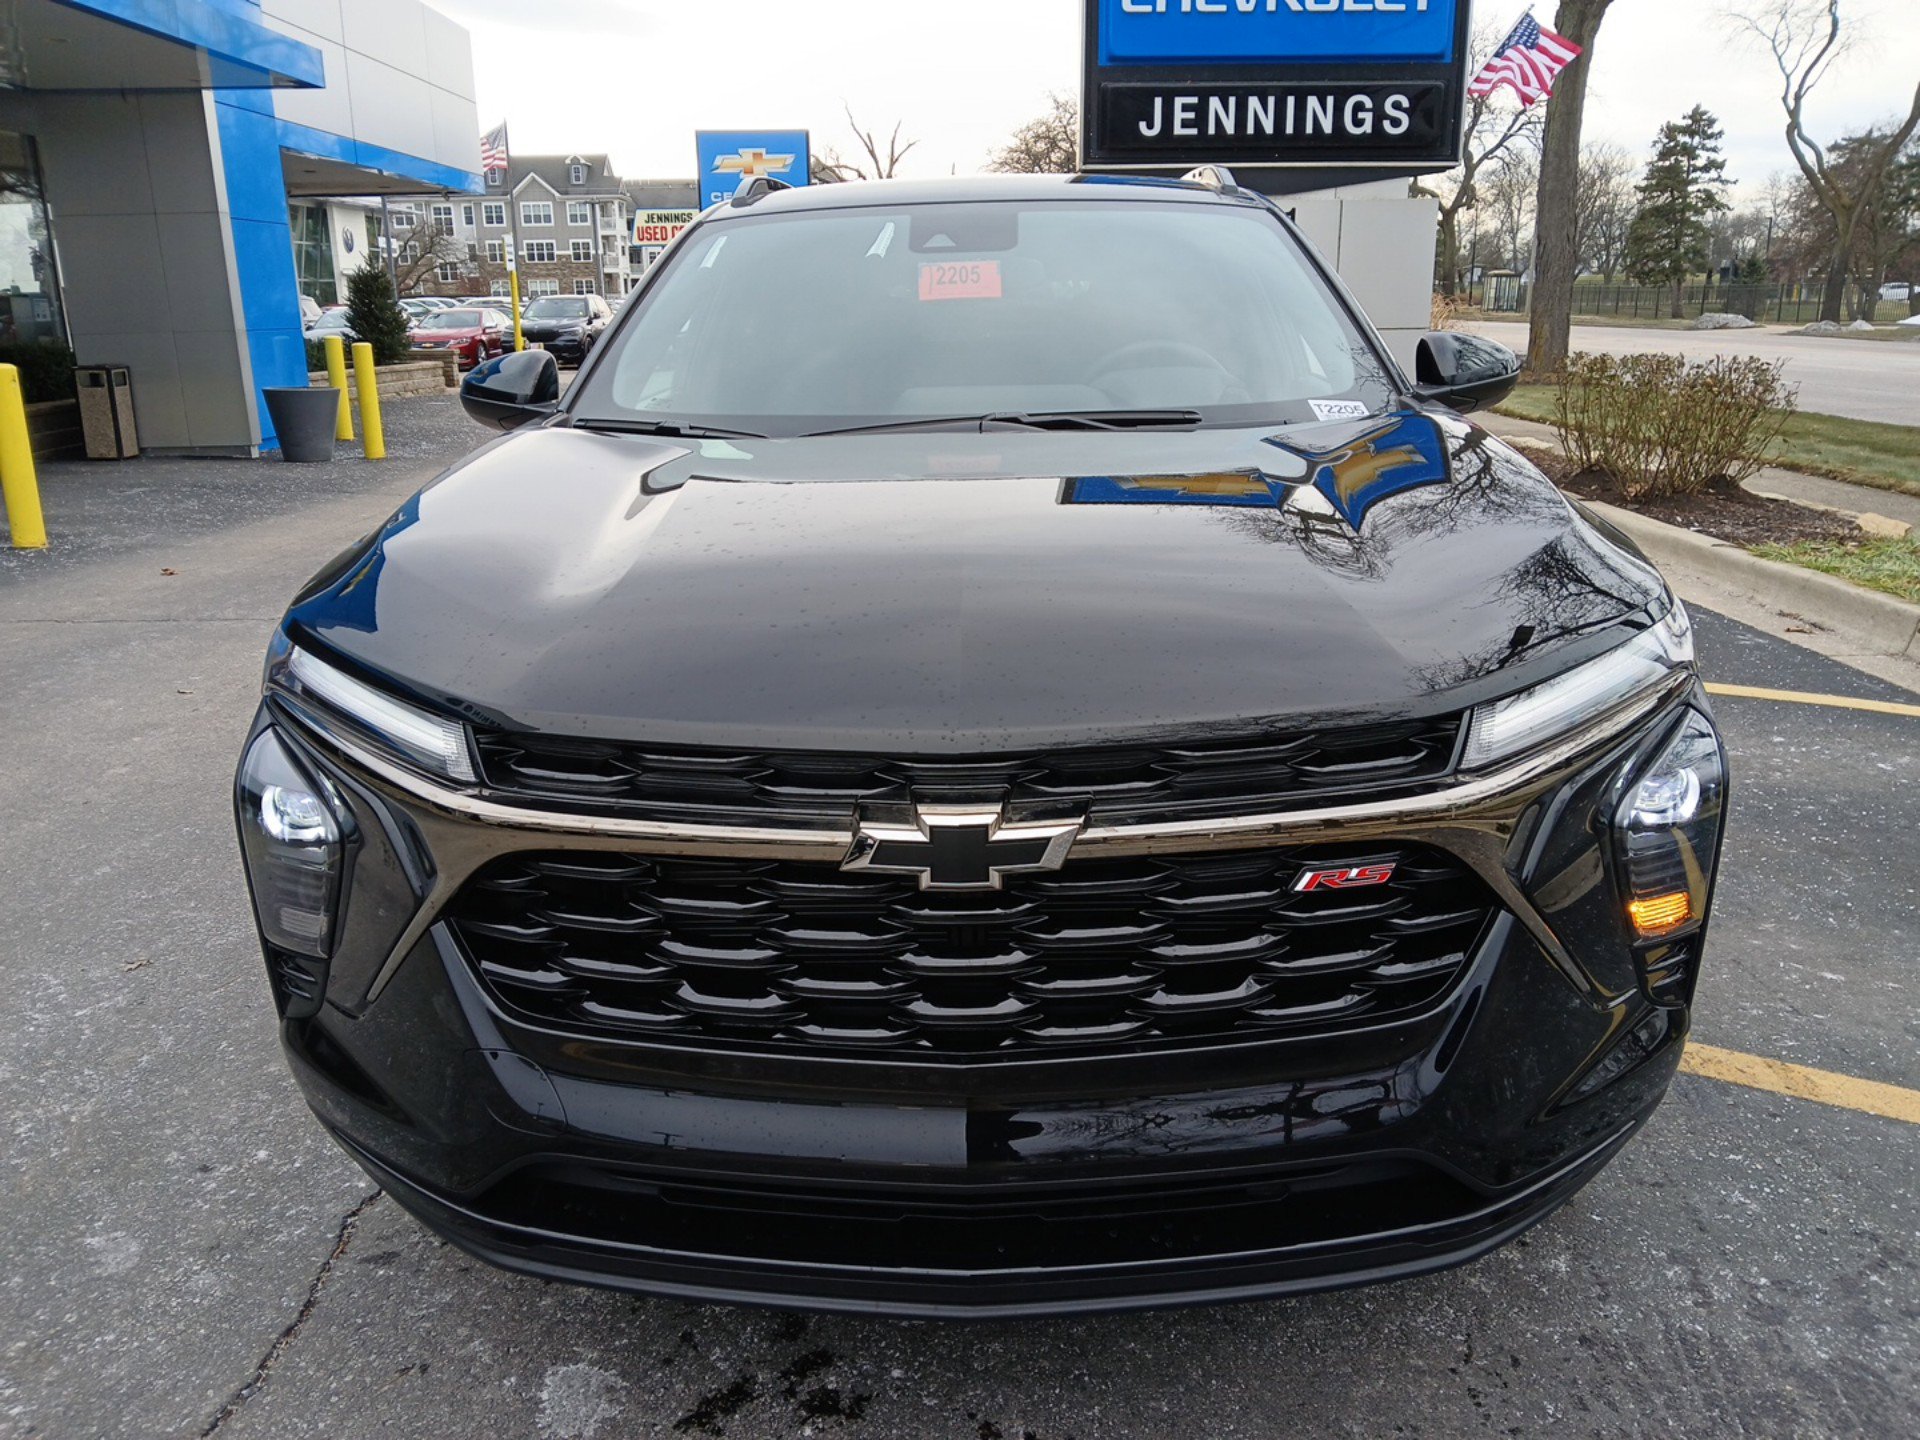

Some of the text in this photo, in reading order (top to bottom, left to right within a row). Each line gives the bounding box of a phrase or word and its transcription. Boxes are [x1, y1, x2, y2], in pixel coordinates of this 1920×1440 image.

[1138, 93, 1410, 137] JENNINGS
[644, 212, 693, 224] JENNINGS
[636, 225, 668, 242] USED
[1313, 403, 1365, 416] T2205
[1294, 862, 1397, 892] RS
